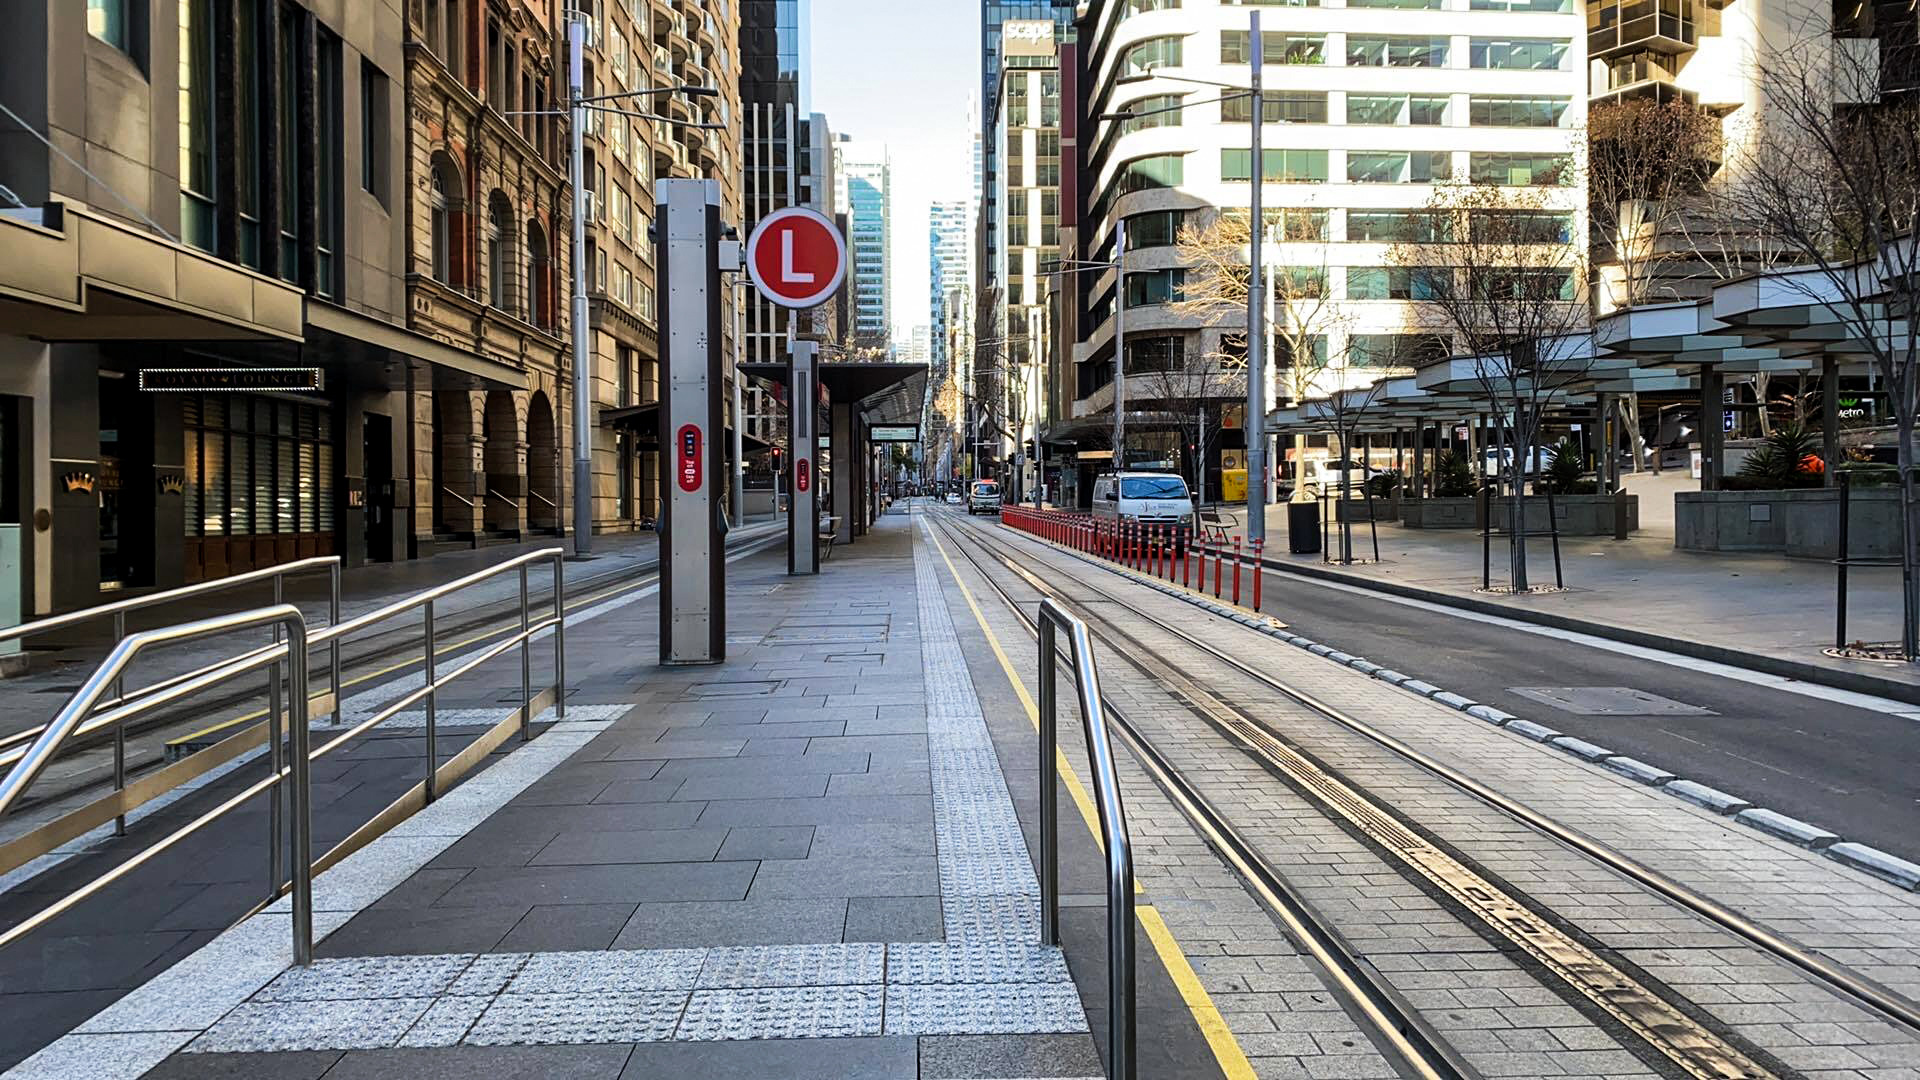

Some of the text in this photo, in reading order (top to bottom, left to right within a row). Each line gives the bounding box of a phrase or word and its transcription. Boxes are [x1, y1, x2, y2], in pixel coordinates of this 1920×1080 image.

[1007, 23, 1052, 44] scape
[781, 229, 815, 283] L
[233, 374, 302, 384] LOUNGE
